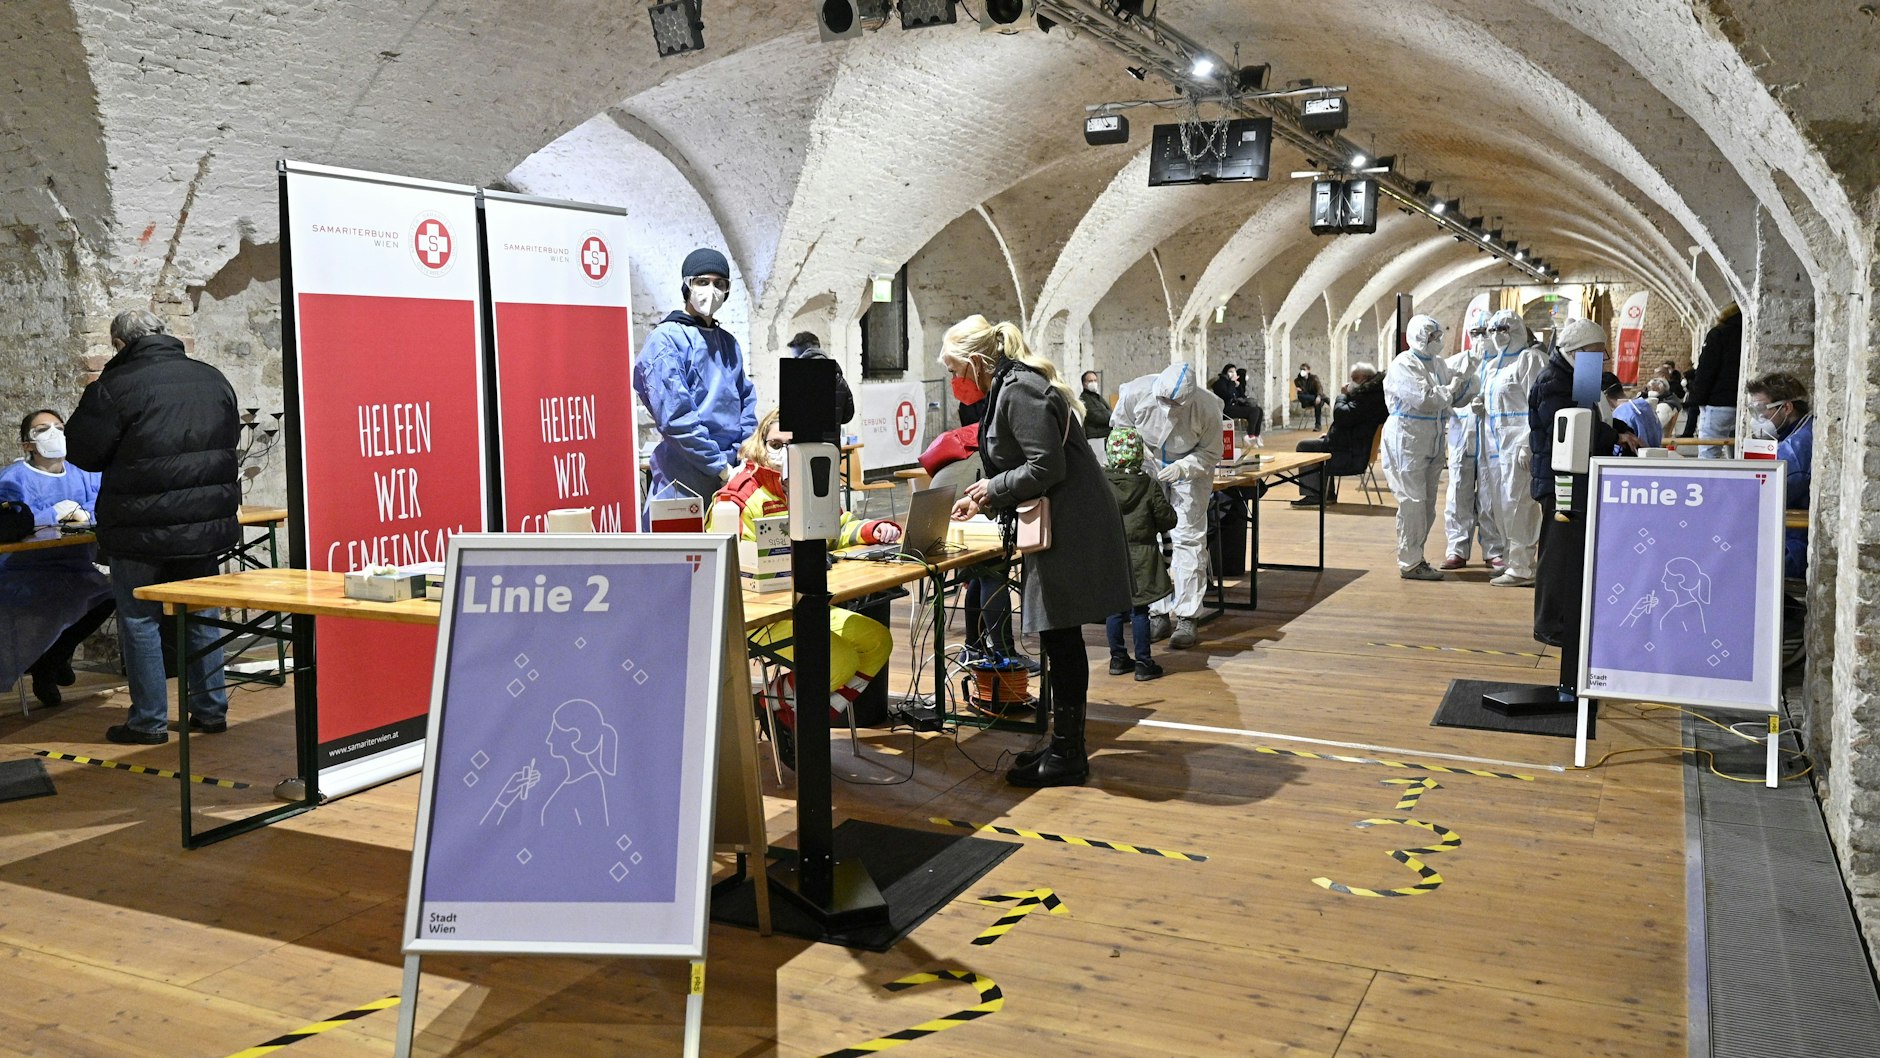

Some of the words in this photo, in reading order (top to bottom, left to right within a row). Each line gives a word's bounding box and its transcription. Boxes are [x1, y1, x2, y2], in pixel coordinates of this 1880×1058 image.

[312, 224, 399, 240] SAMARITERBUND
[374, 240, 399, 249] WIEN
[428, 235, 439, 252] S
[503, 243, 570, 256] SAMARITERBUND
[550, 256, 570, 264] WIEN
[591, 250, 600, 266] S
[540, 394, 596, 444] HELFEN
[903, 415, 910, 431] S
[358, 401, 431, 458] HELFEN
[553, 452, 590, 500] WIR
[373, 467, 422, 523] WIR
[1602, 480, 1678, 506] Linie
[1684, 483, 1704, 507] 3
[462, 574, 573, 614] Linie
[583, 574, 610, 612] 2
[1590, 673, 1608, 681] Stadt
[328, 731, 399, 757] www.samariterwien.at
[1311, 818, 1462, 898] 3
[430, 912, 457, 923] Stadt
[429, 923, 456, 934] Wien
